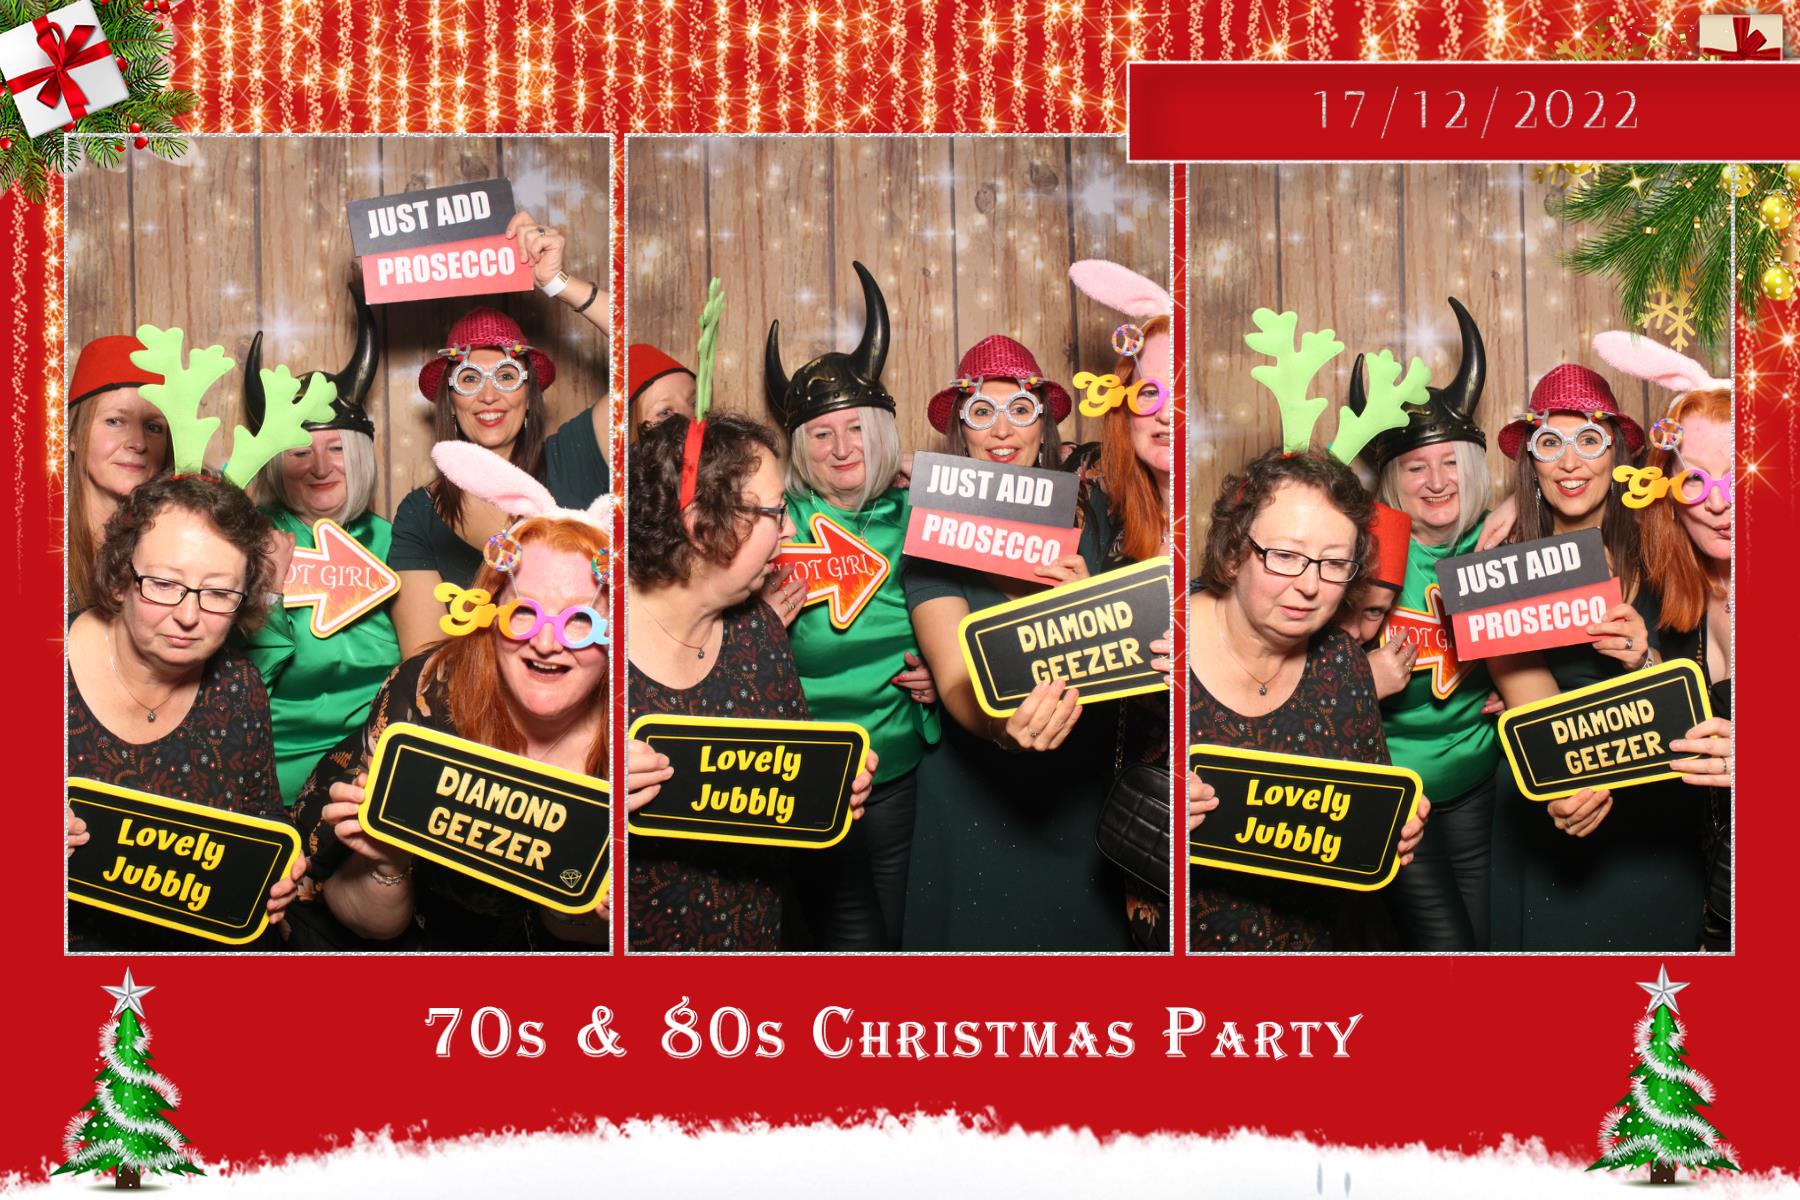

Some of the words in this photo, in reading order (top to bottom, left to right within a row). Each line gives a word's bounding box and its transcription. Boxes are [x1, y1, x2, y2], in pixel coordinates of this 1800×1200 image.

[367, 199, 430, 240] JUST
[437, 190, 491, 227] ADD
[377, 246, 516, 288] PROSECCO
[926, 463, 993, 501] JUST
[996, 473, 1054, 508] ADD
[921, 513, 1061, 567] PROSECCO
[284, 563, 316, 585] OT
[320, 564, 378, 592] GIRL
[827, 554, 875, 580] GIRL
[1456, 553, 1519, 597] JUST
[1525, 541, 1582, 581] ADD
[1016, 600, 1134, 654] DIAMOND
[1467, 595, 1607, 643] PROSECCO
[1031, 637, 1145, 686] GEEZER
[1551, 698, 1655, 745] DIAMOND
[699, 744, 802, 782] Lovely
[1564, 730, 1665, 775] GEEZER
[435, 765, 568, 833] DIAMOND
[690, 783, 796, 824] Jubbly
[1246, 779, 1351, 822] Lovely
[117, 818, 226, 871] Lovely
[427, 806, 552, 871] GEEZER
[1234, 816, 1342, 863] Jubbly
[102, 855, 211, 912] Jubbly
